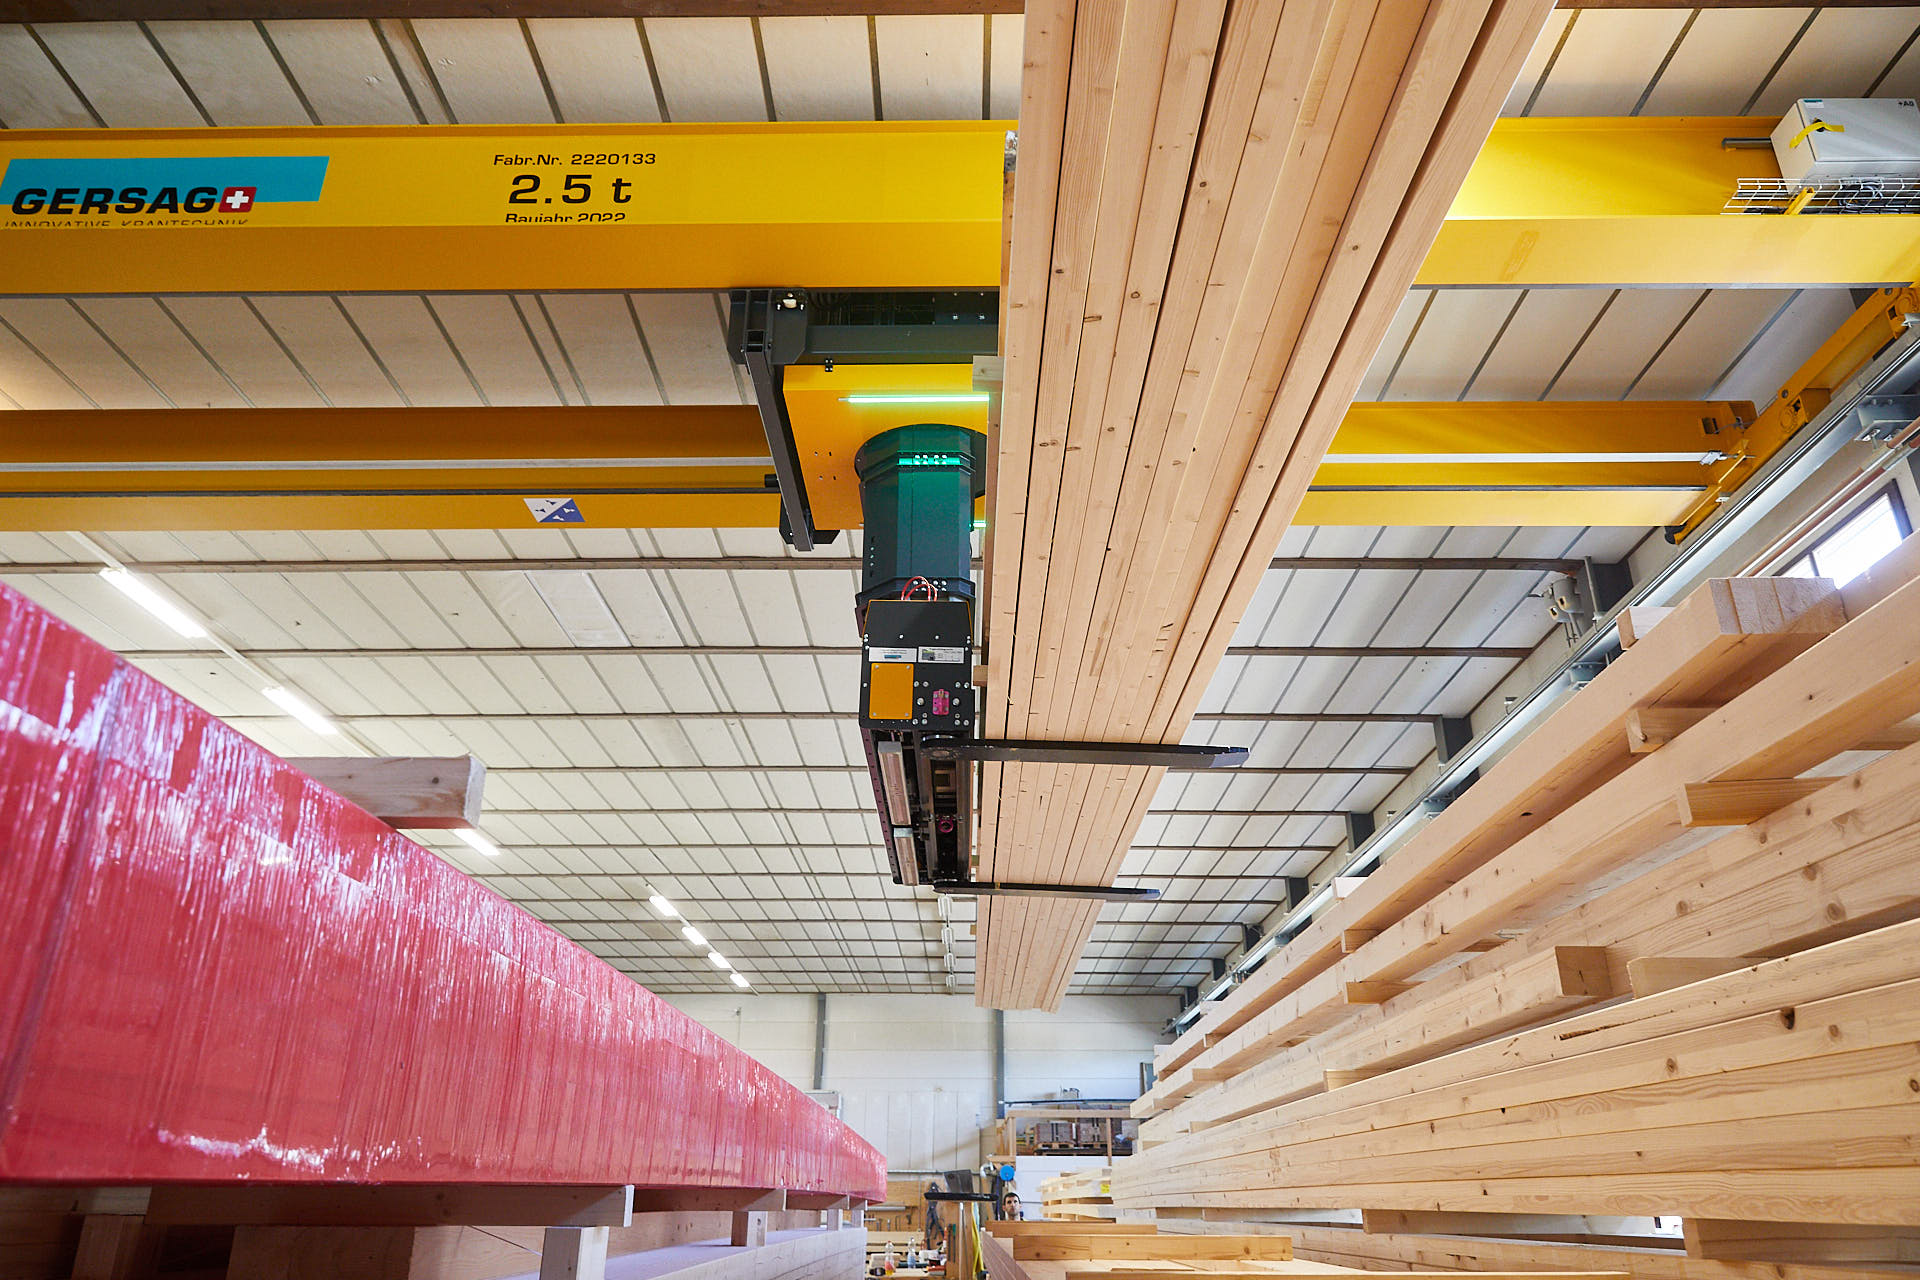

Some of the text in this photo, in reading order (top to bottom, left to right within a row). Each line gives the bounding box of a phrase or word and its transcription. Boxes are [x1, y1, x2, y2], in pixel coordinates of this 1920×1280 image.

[493, 153, 656, 165] Fabr.Nr. 2220133
[11, 186, 218, 215] GERSAG
[508, 174, 632, 204] 2.5 t
